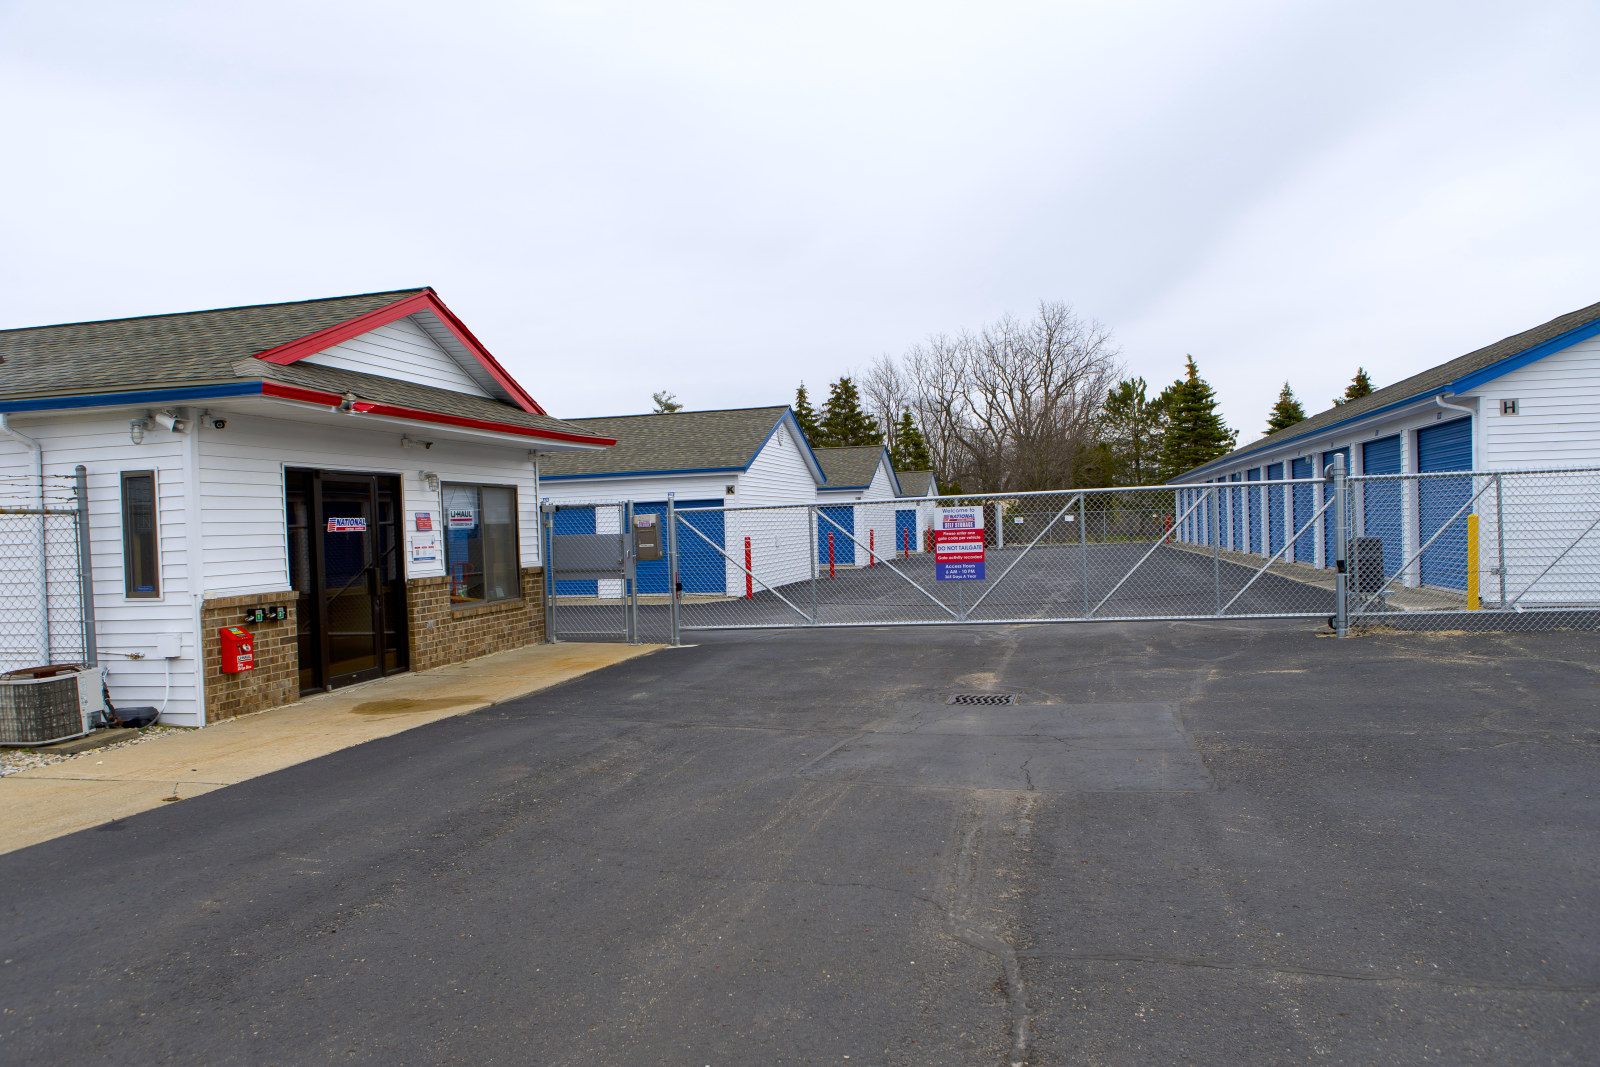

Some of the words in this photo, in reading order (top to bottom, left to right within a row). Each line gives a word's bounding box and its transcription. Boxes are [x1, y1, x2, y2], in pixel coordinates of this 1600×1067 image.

[1503, 400, 1516, 414] H
[727, 486, 735, 494] K
[336, 518, 366, 527] NATIONAL
